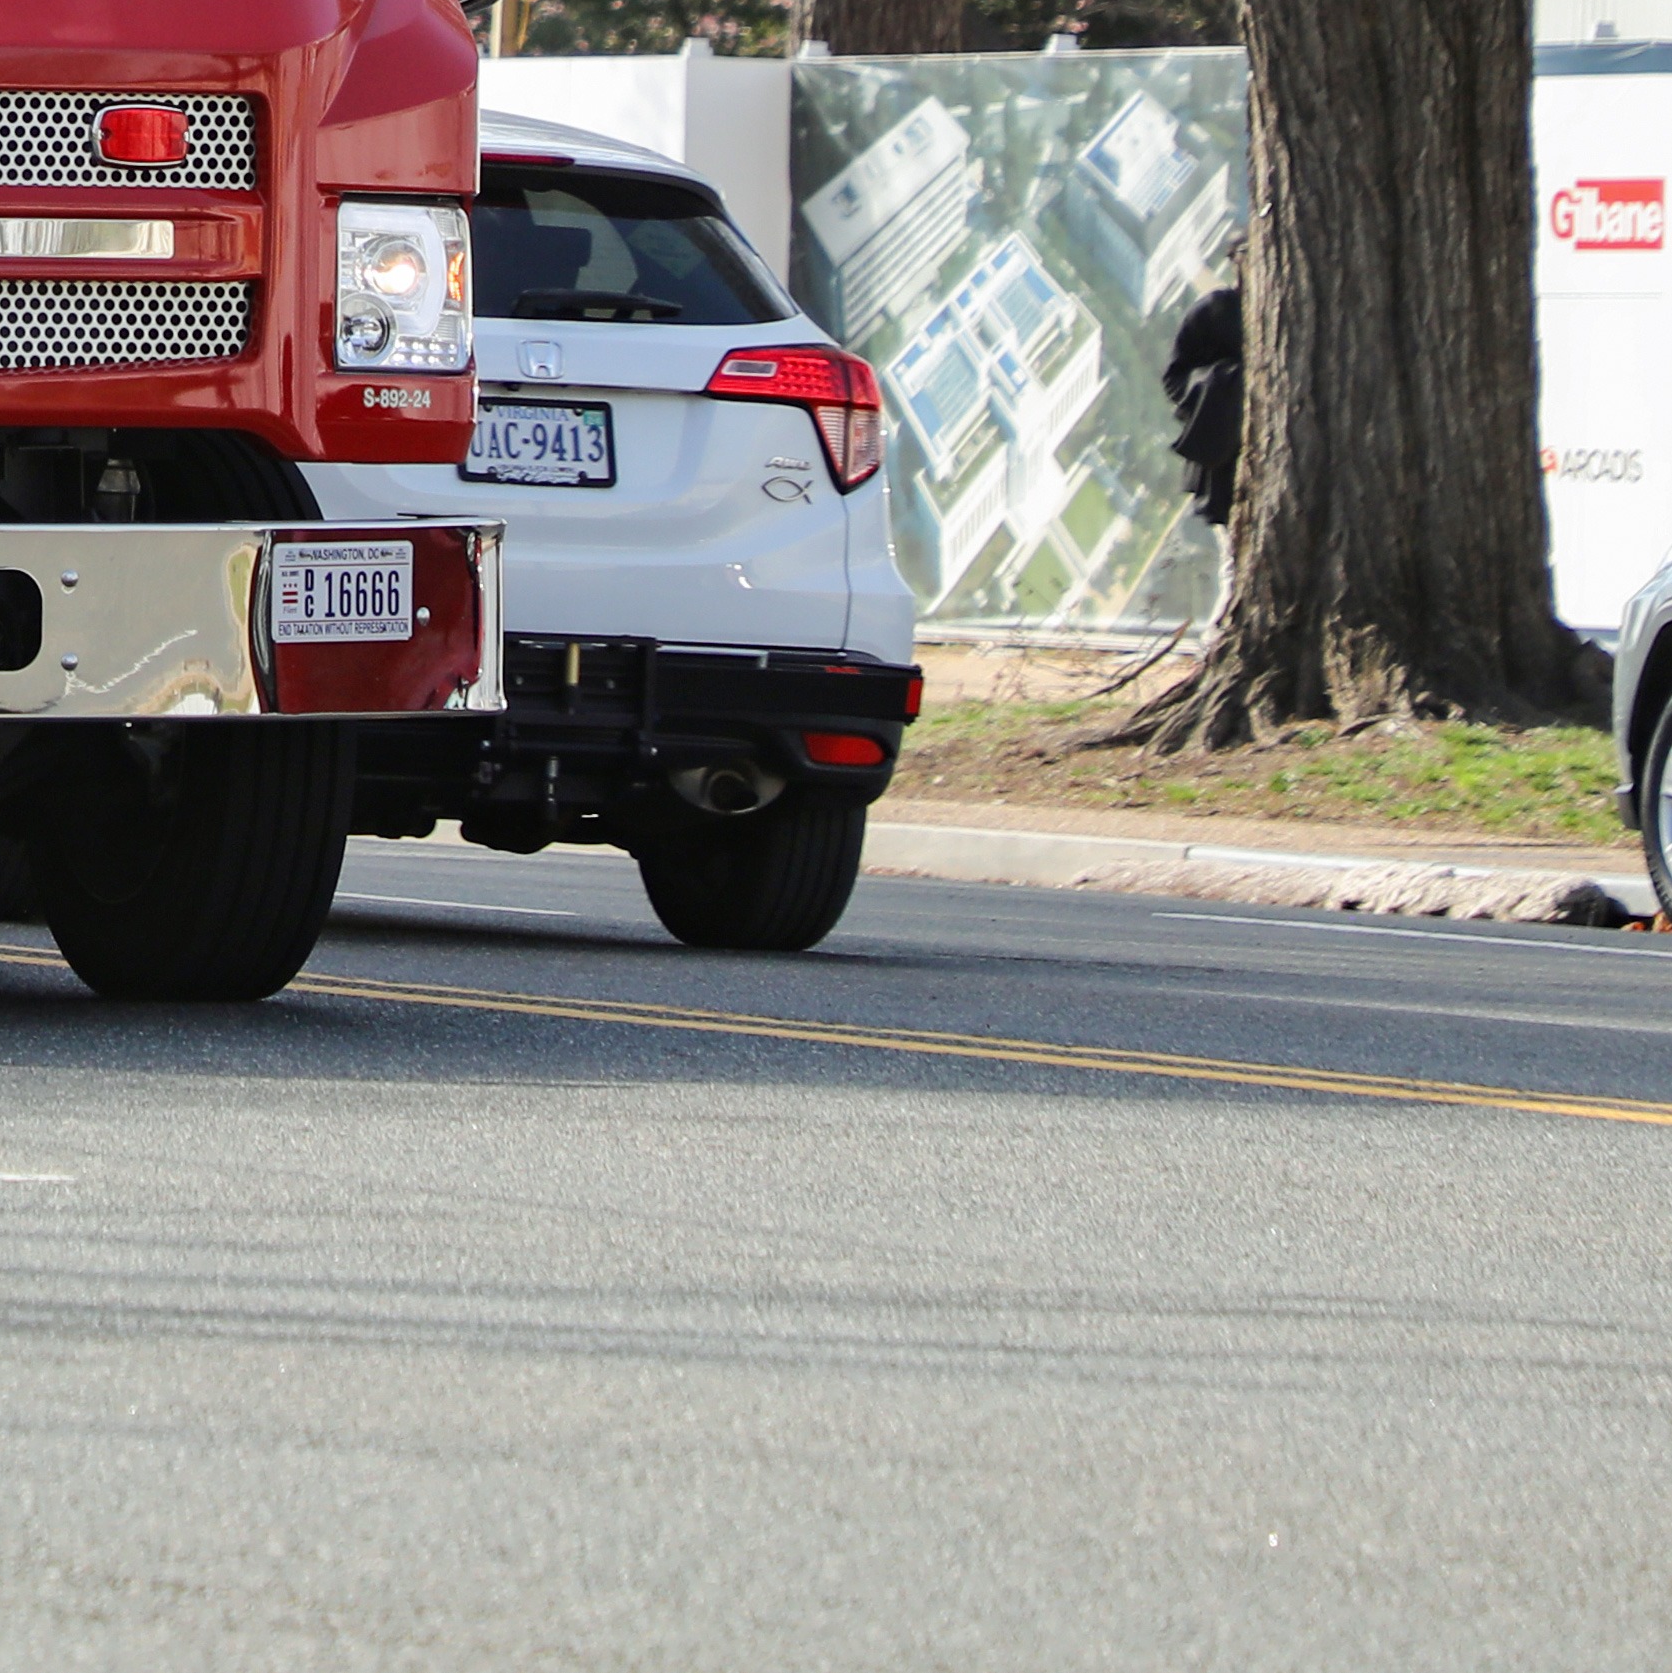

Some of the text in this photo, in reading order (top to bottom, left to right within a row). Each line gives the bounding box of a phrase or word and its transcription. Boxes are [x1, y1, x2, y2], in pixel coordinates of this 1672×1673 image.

[1550, 185, 1664, 245] Gilbane
[363, 387, 431, 408] S-892-24
[496, 405, 569, 422] VIRGINIA
[470, 420, 604, 462] UAC-9413
[1559, 449, 1643, 483] ARCADIS
[312, 547, 379, 561] WASHINGTON, DC
[324, 570, 400, 618] 16666
[278, 624, 292, 637] END
[293, 623, 324, 636] TAXATION
[325, 622, 353, 635] WITHOUT
